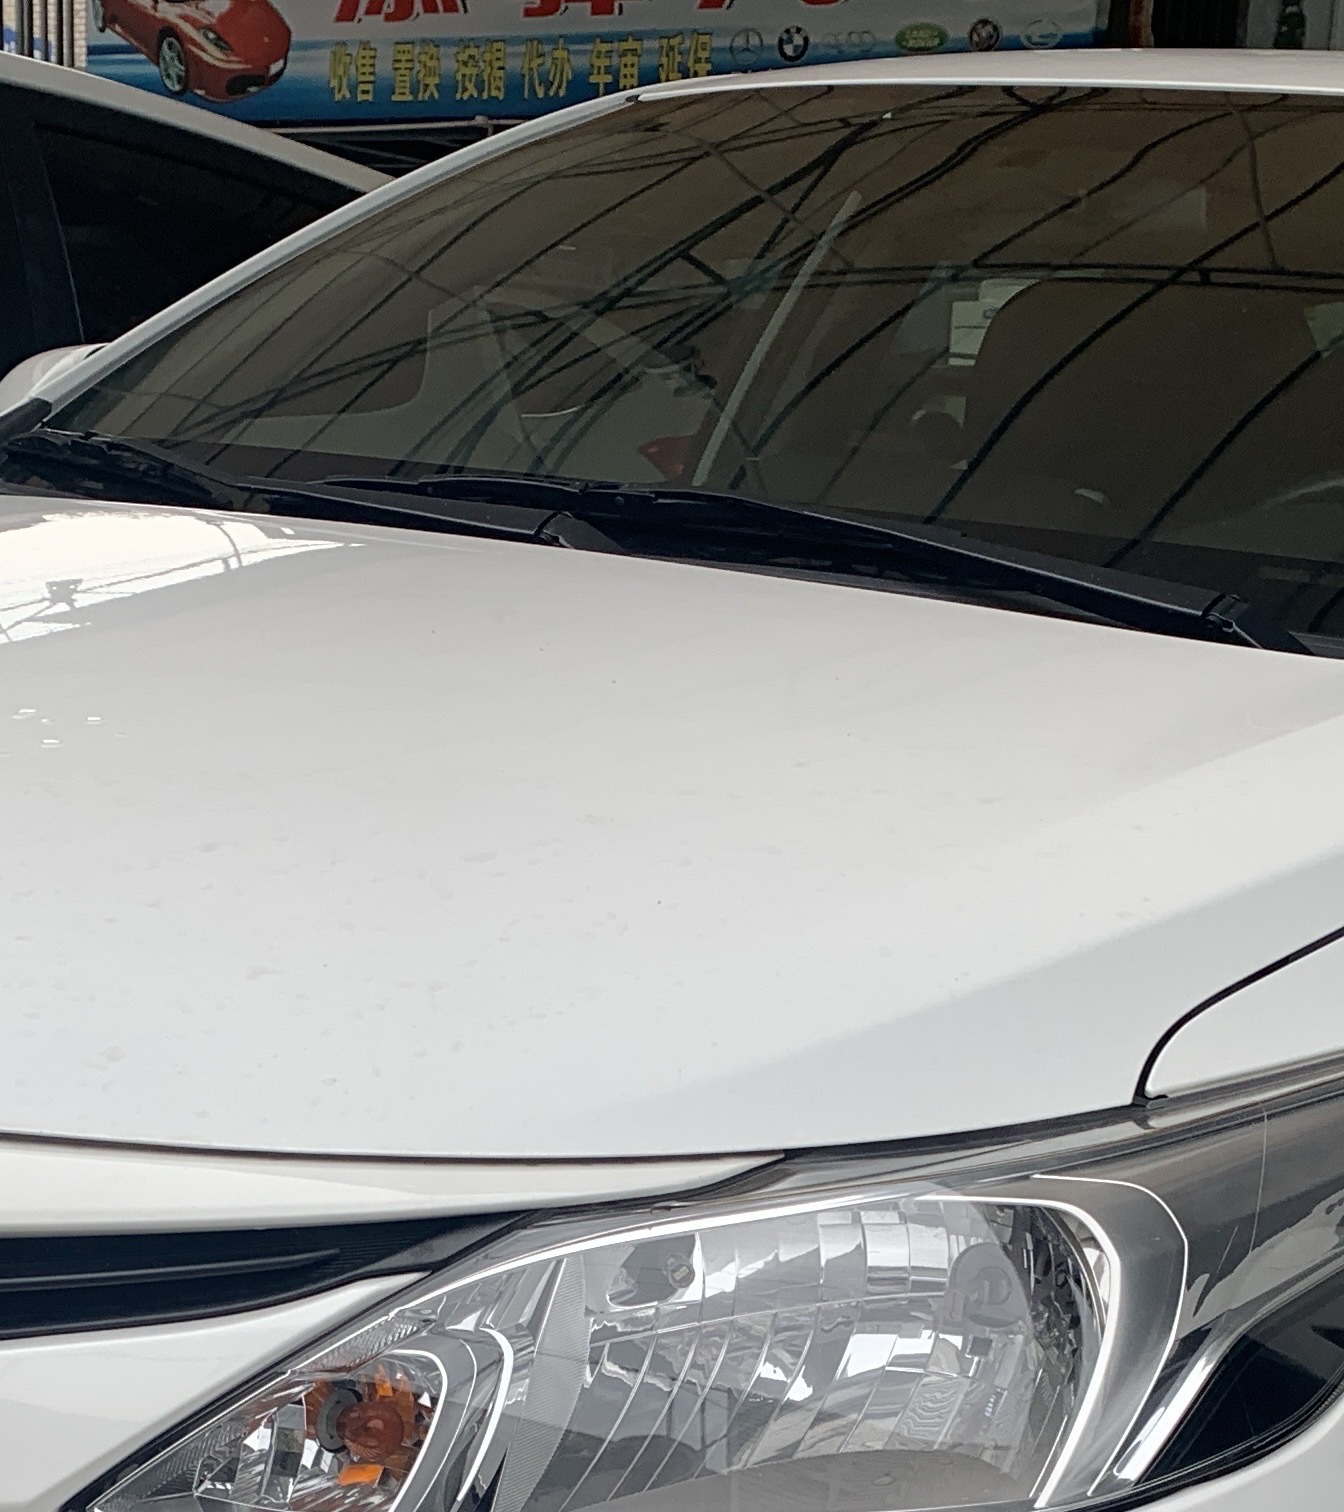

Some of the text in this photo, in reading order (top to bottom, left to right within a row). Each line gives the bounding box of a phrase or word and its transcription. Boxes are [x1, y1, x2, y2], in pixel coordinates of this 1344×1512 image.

[329, 31, 713, 101] 收售 置换 按揭 代办 年审 延保
